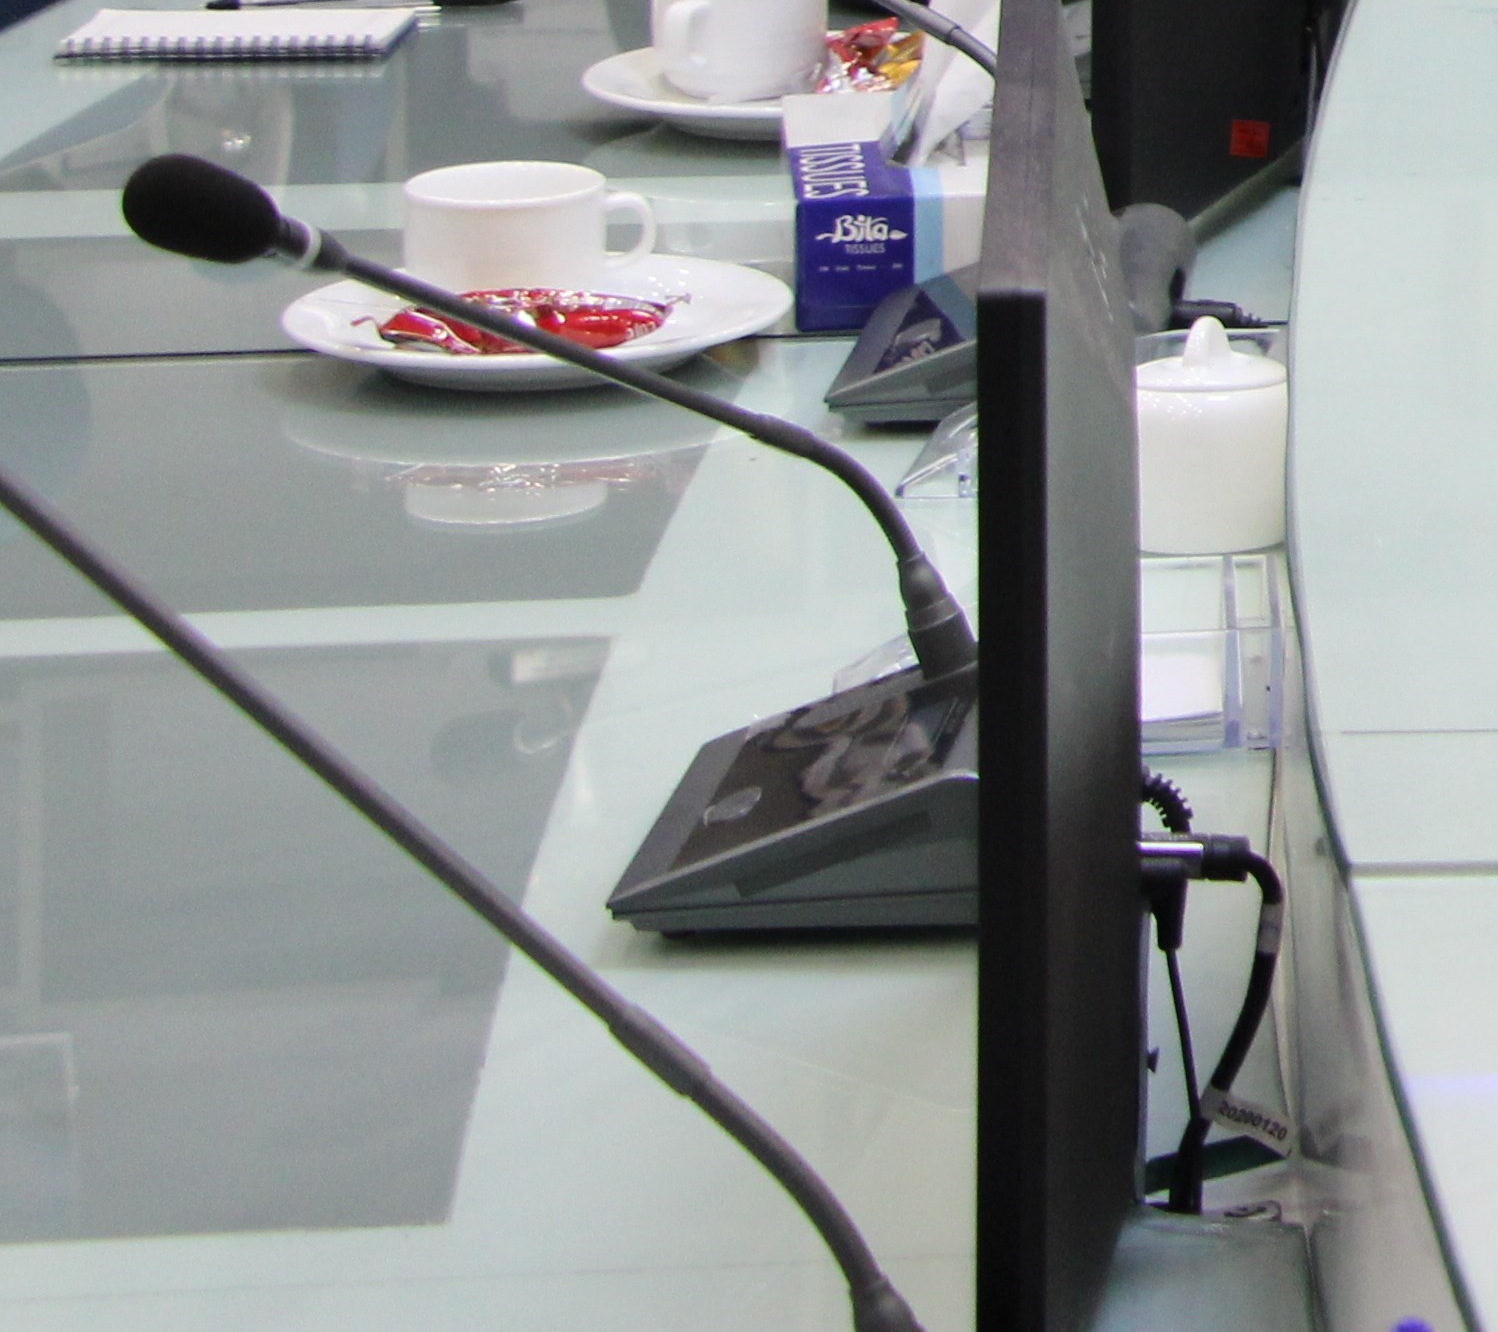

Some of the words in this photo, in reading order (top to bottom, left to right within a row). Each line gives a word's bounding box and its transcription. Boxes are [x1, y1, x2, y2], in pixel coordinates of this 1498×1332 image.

[800, 143, 869, 199] TISSUES
[815, 214, 890, 244] Bita
[845, 242, 887, 254] TISSUES
